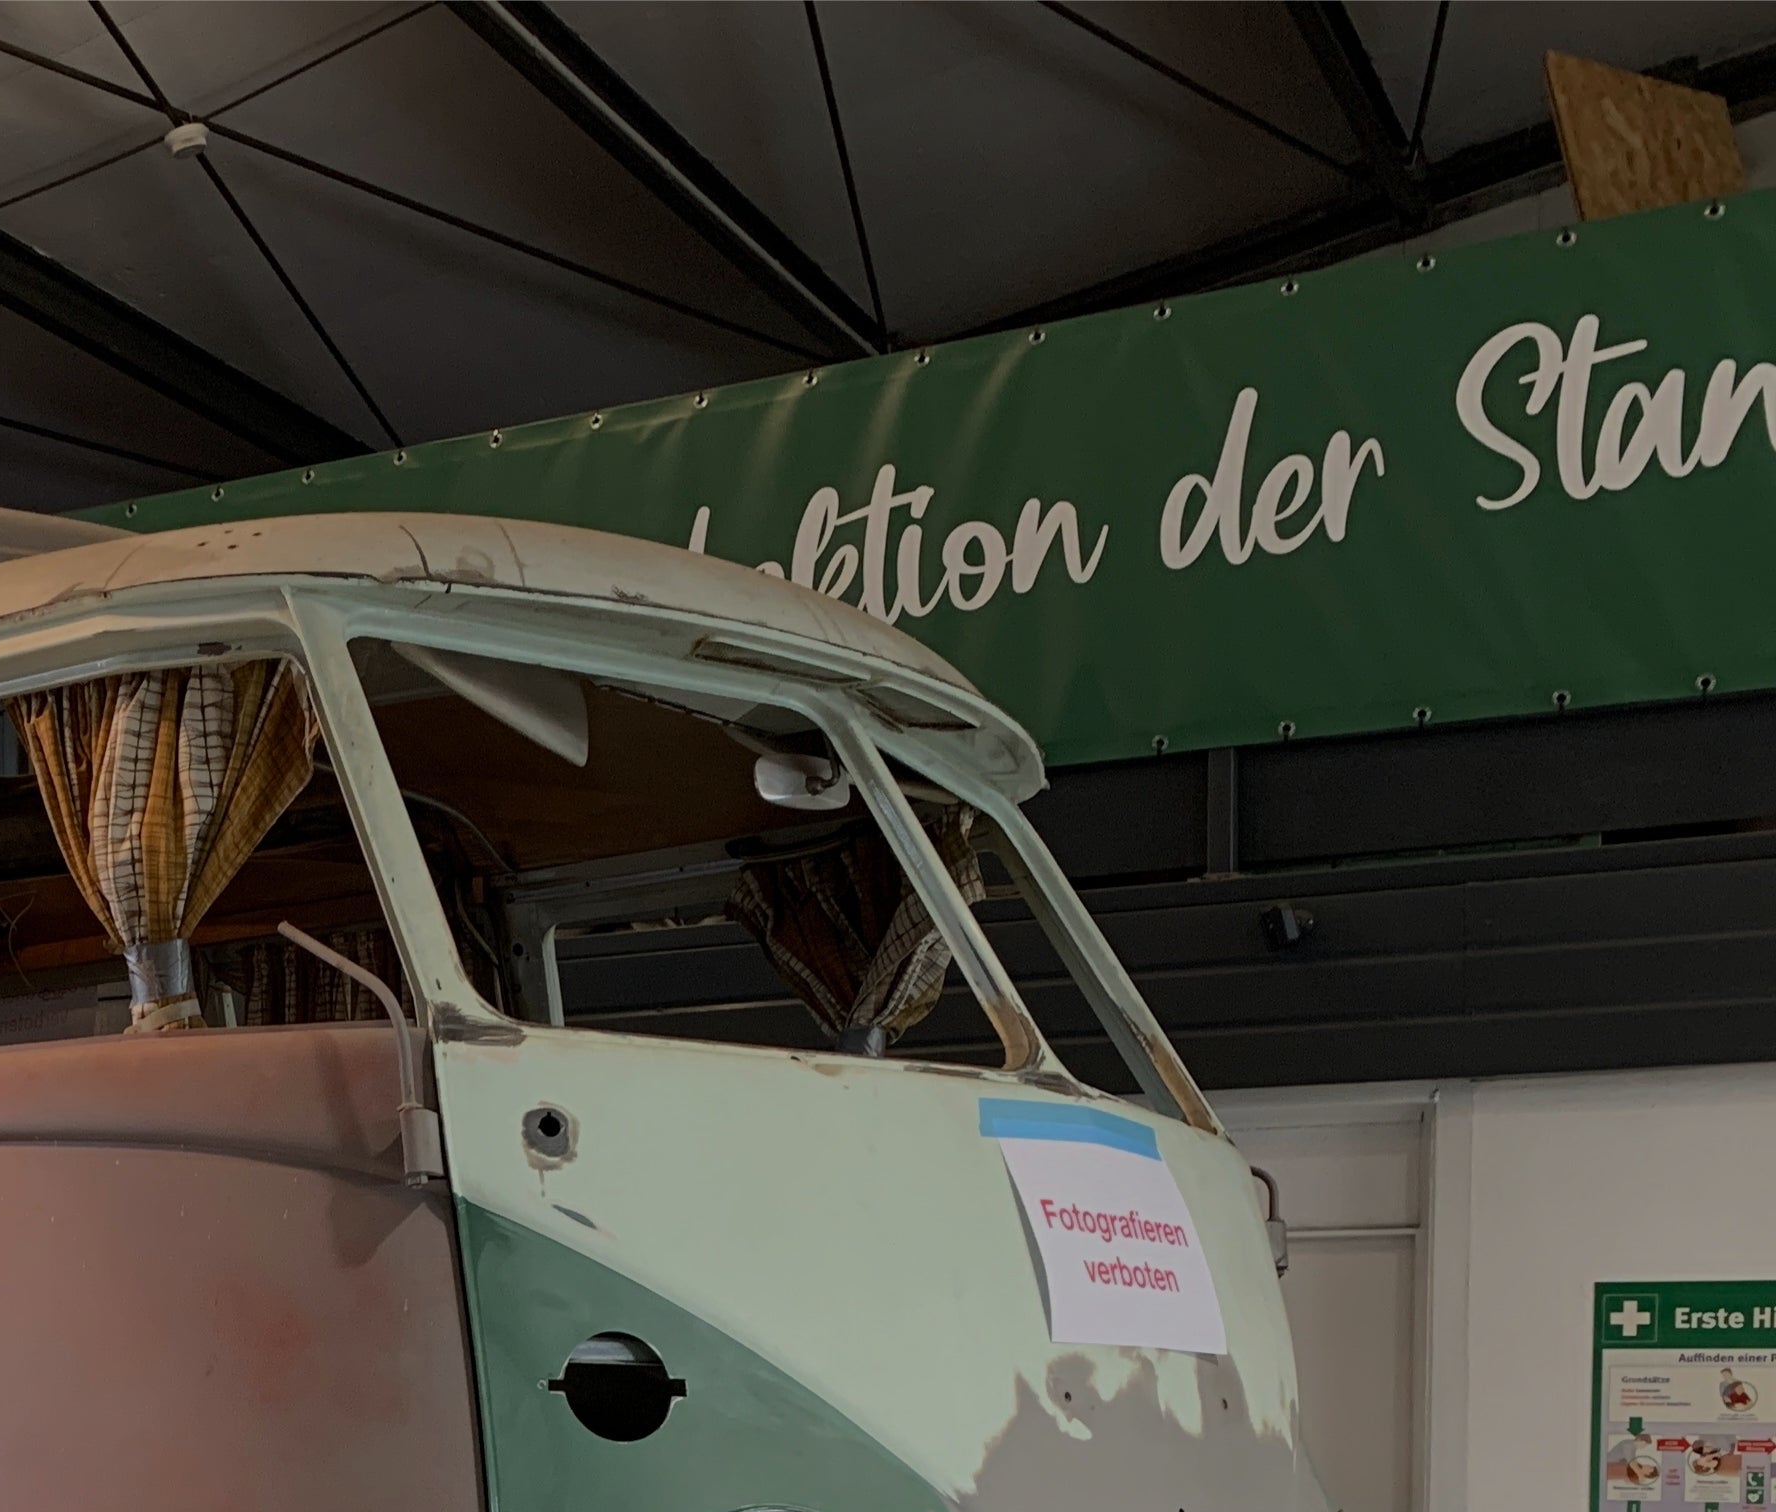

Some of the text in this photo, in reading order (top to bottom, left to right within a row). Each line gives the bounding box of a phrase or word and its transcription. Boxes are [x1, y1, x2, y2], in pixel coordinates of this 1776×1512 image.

[688, 464, 1109, 628] ktion
[1160, 388, 1385, 570] der
[1039, 1198, 1189, 1247] Fotografieren
[1083, 1256, 1180, 1292] verboten
[1674, 1306, 1745, 1329] Erste
[1678, 1353, 1734, 1363] Auffinden
[1738, 1353, 1767, 1363] einer
